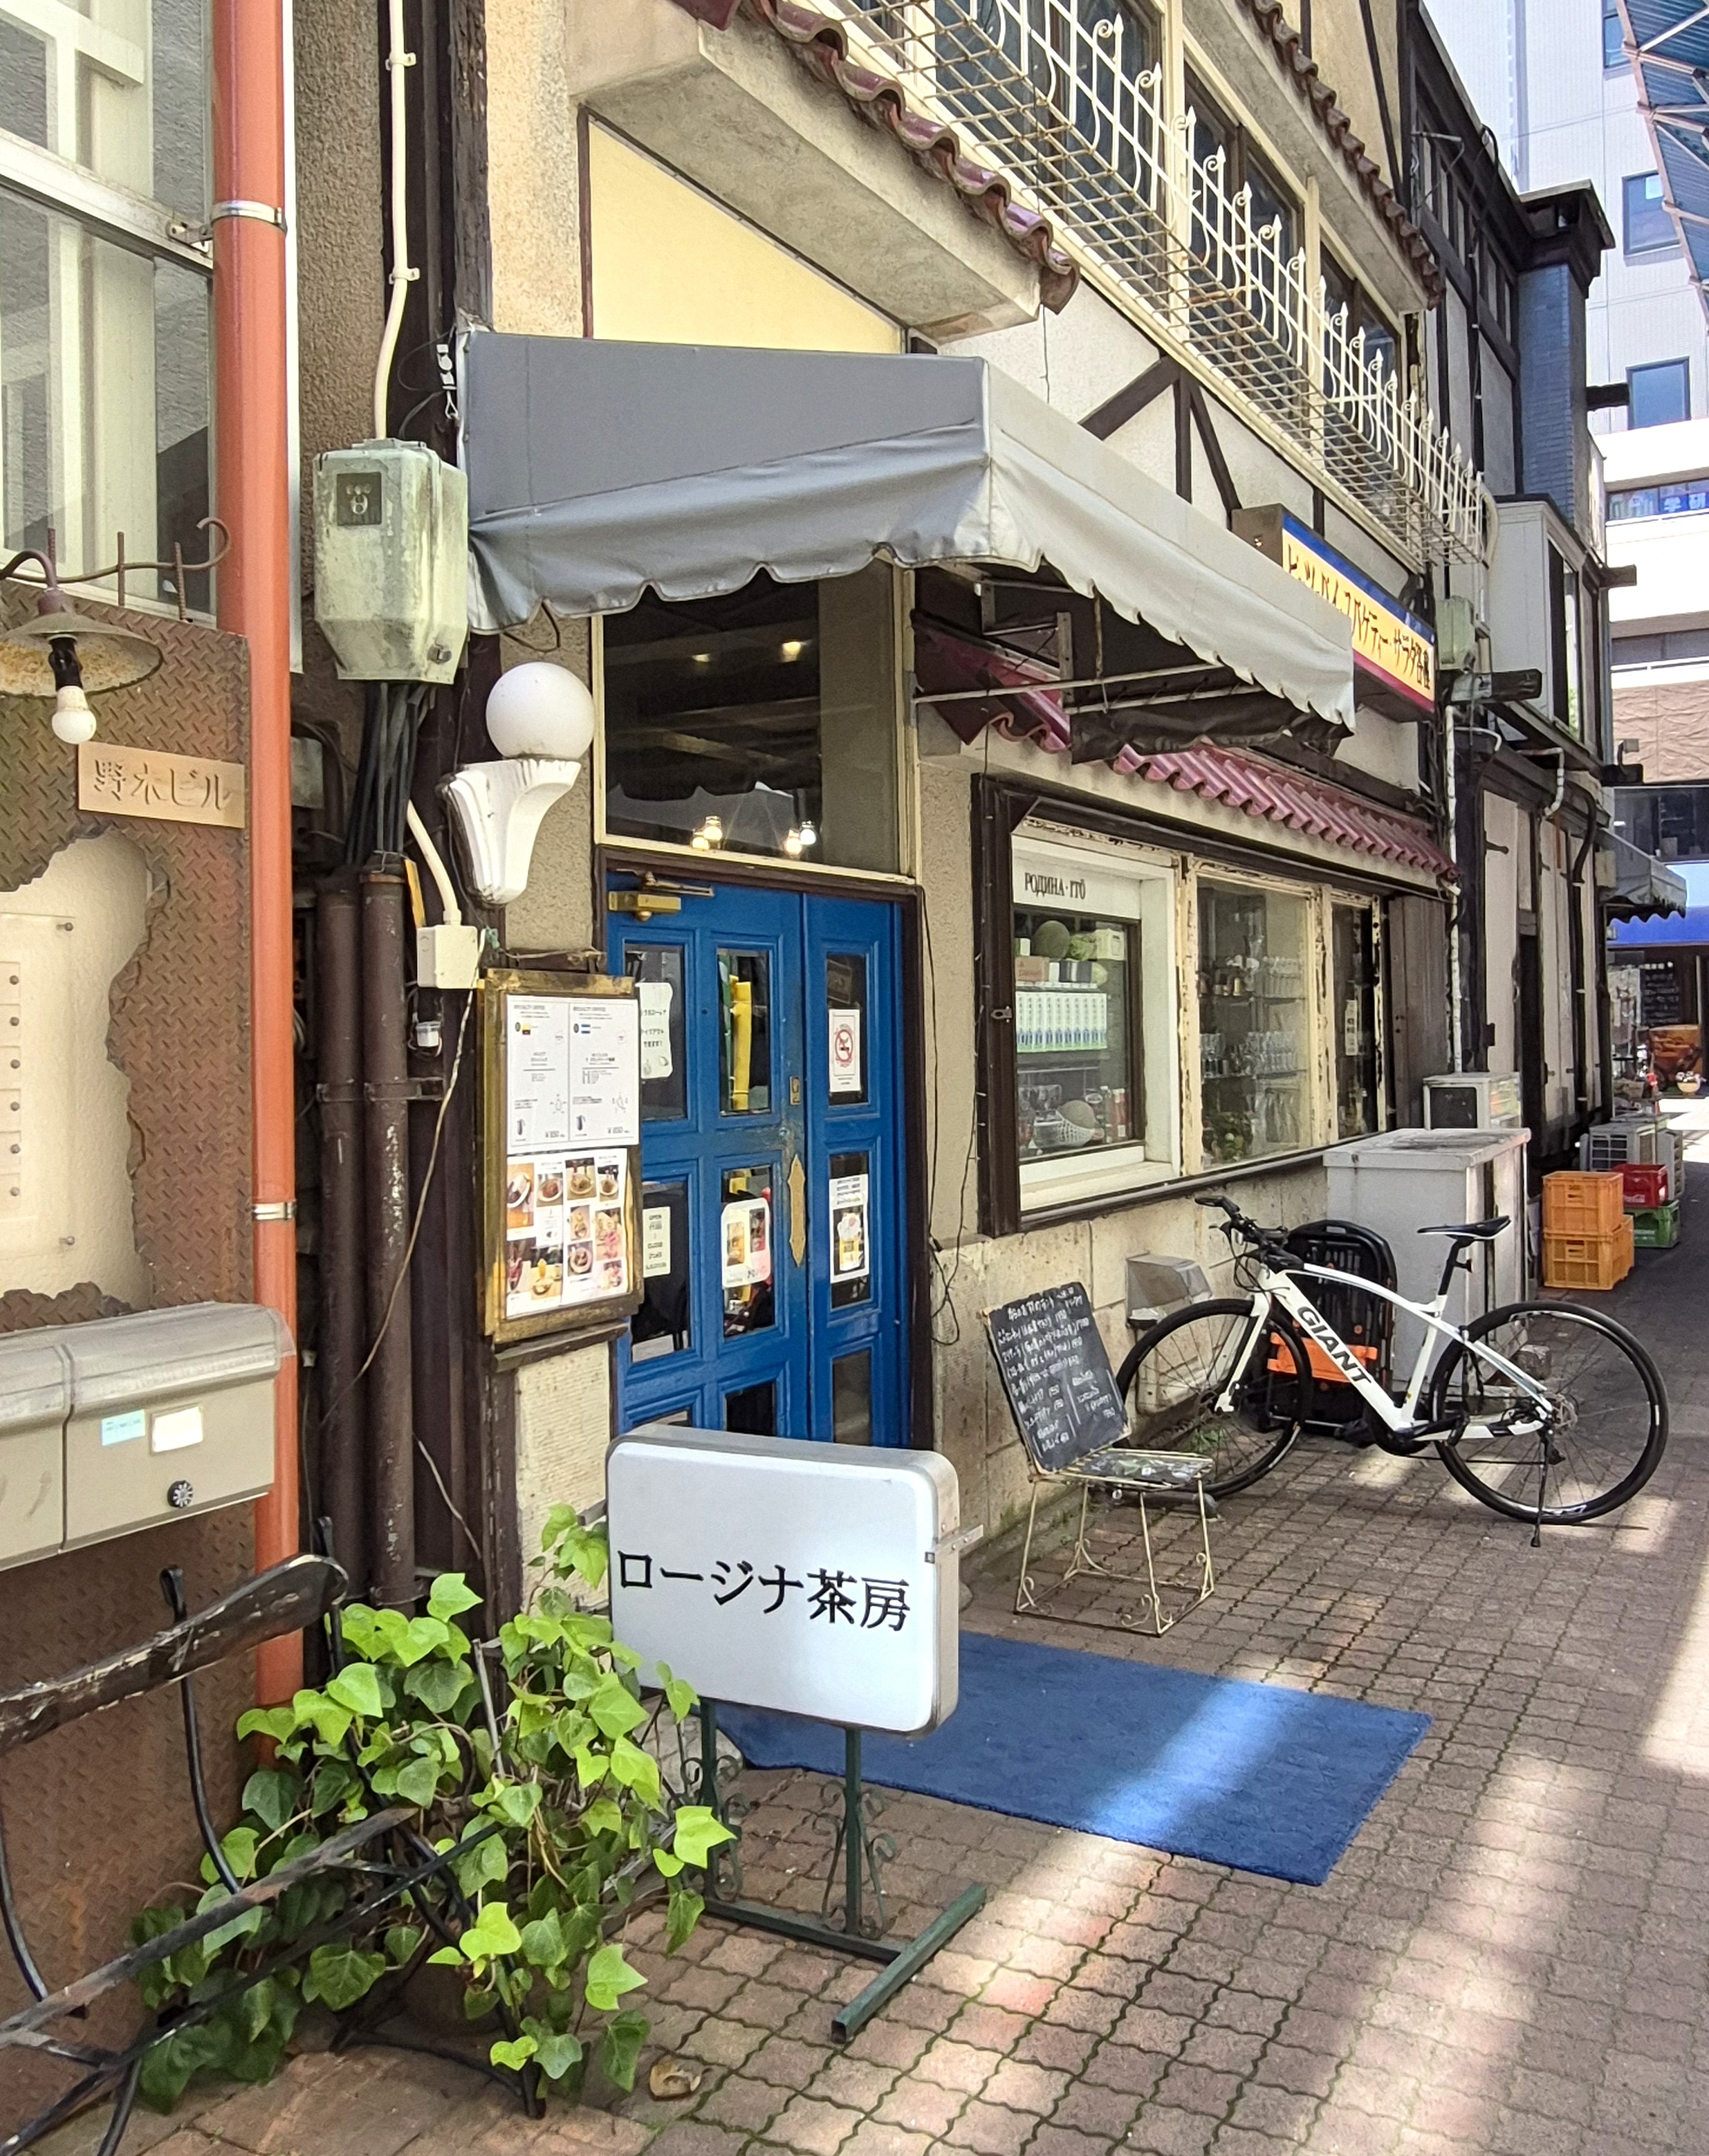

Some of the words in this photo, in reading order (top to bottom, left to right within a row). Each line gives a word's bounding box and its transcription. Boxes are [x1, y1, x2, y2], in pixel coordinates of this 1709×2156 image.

[93, 759, 230, 811] 野木ビル
[1297, 1306, 1372, 1384] GIANT
[617, 1549, 911, 1632] ロージナ茶房
